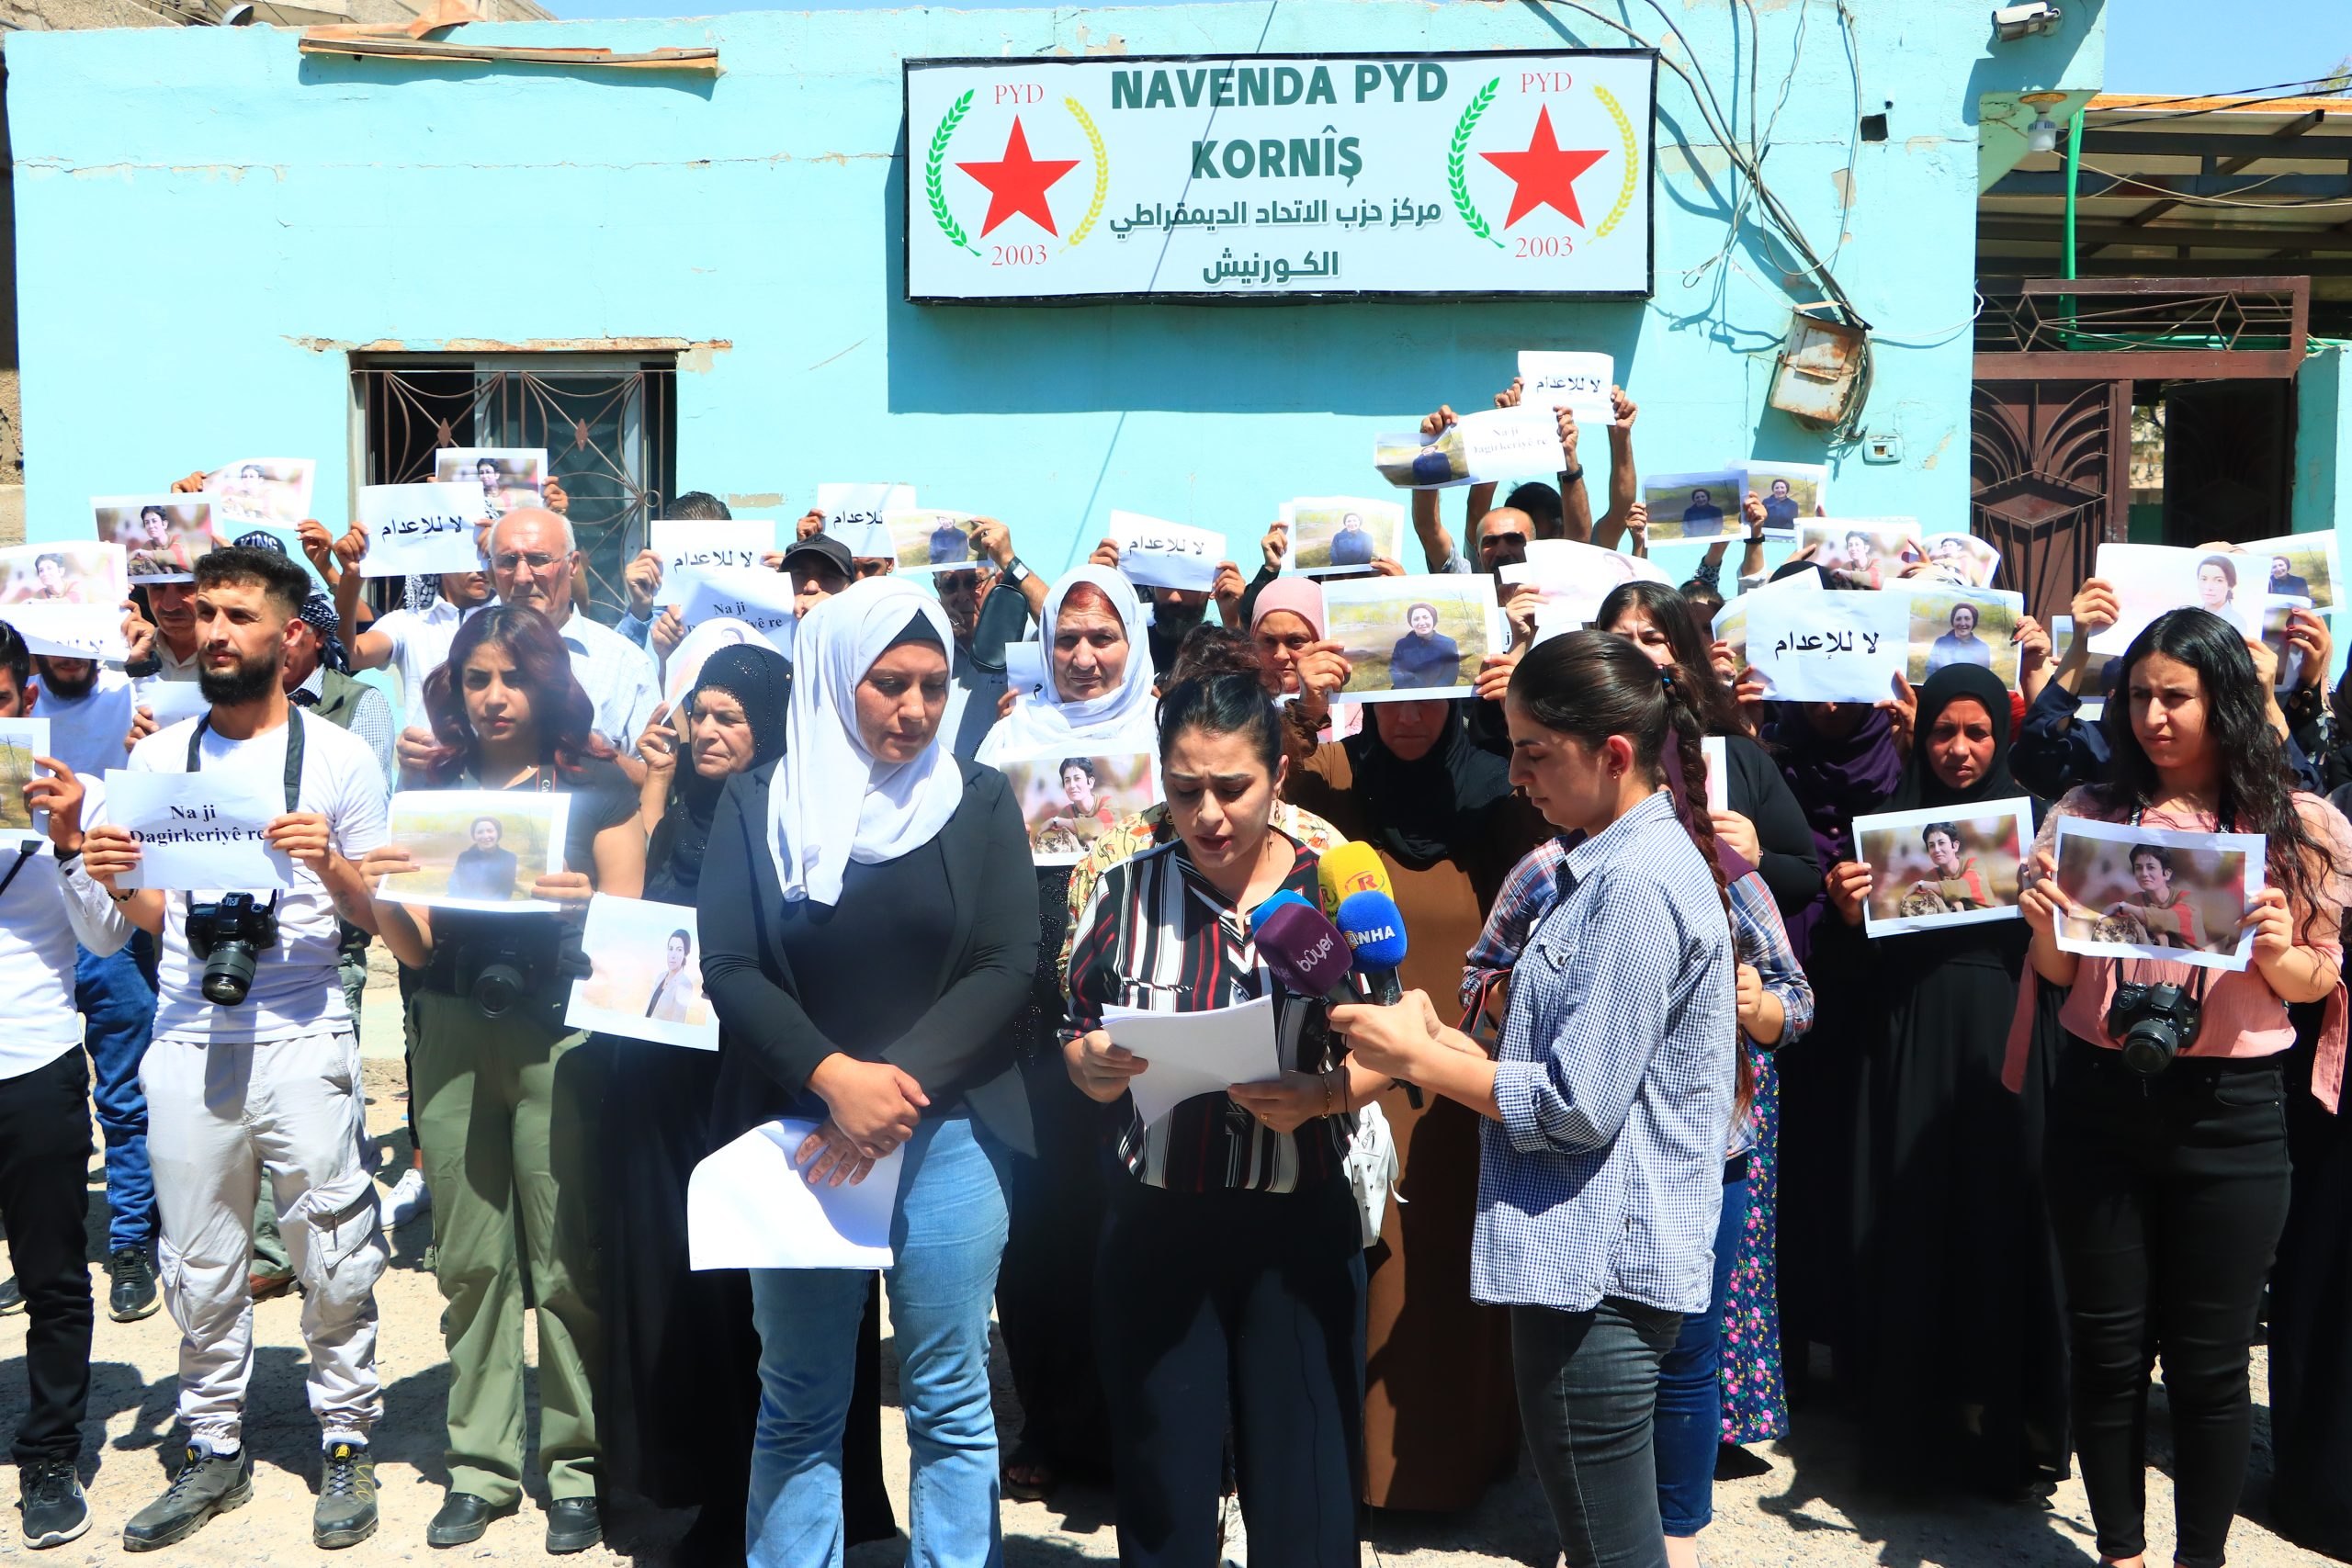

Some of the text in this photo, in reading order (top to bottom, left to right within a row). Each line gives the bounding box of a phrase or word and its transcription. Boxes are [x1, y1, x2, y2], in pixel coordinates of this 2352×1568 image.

[1111, 62, 1449, 109] NAVENDA PYD
[1521, 72, 1573, 94] PYD
[994, 84, 1045, 105] PYD
[1192, 124, 1363, 188] KORNÎŞ
[1109, 197, 1442, 240] مركز حزب الاتحاد الديمقراطي
[991, 243, 1047, 266] 2003
[1515, 235, 1574, 258] 2003
[1590, 379, 1600, 393] لا
[449, 515, 462, 533] لا
[1193, 540, 1204, 556] لا
[740, 550, 752, 568] لا
[713, 602, 746, 615] Na ji
[768, 618, 783, 628] re
[1862, 631, 1879, 654] لا
[170, 805, 216, 822] Na ji
[130, 827, 242, 847] Dagirkeriyê
[1348, 925, 1396, 946] ANHA
[1296, 932, 1335, 972] bûyer
